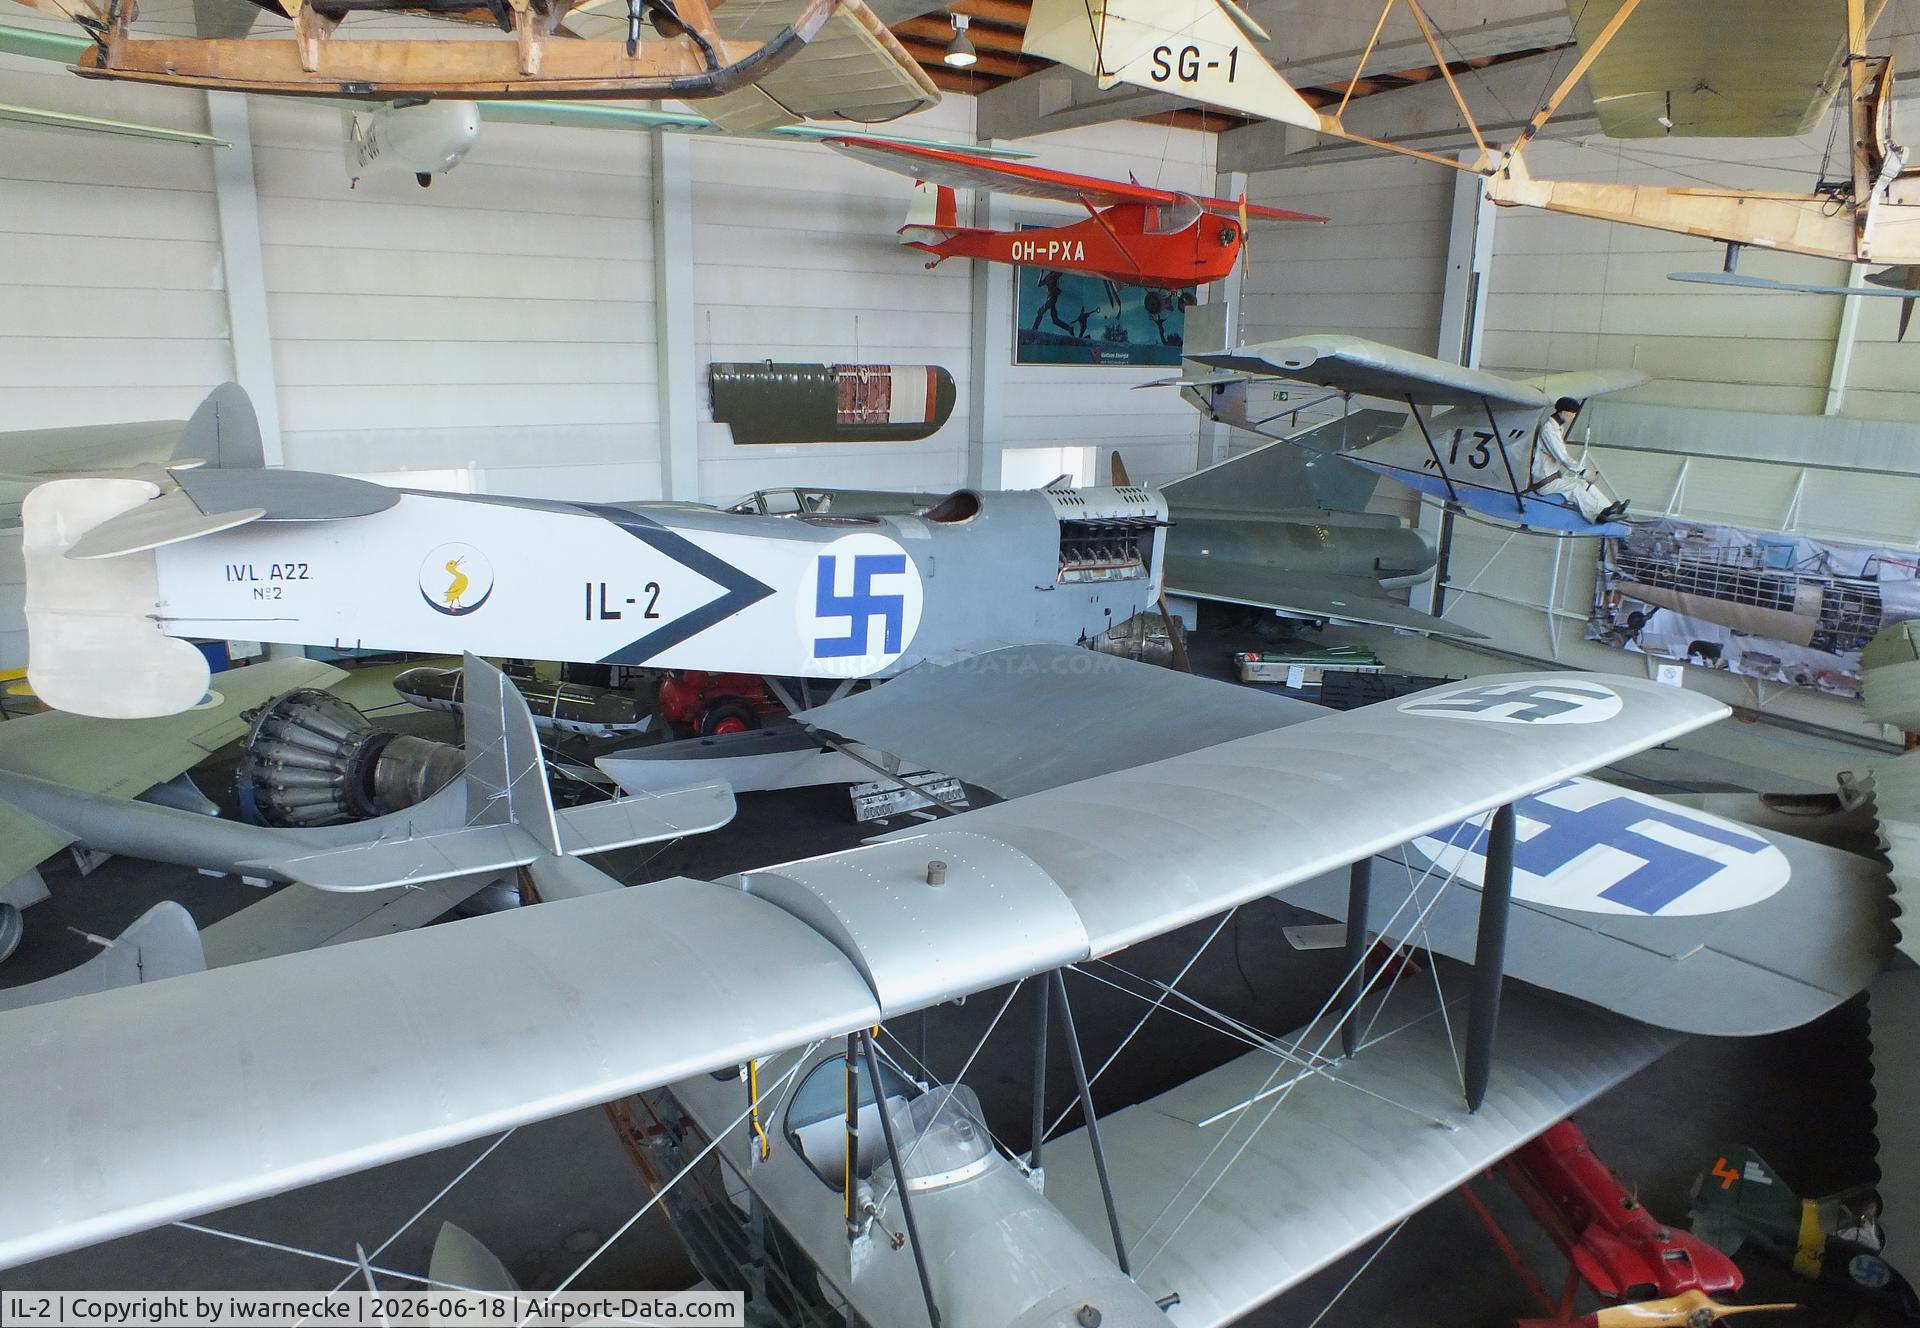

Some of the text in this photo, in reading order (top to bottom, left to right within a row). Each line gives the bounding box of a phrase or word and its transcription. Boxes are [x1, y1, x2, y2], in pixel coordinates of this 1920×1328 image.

[1151, 45, 1239, 83] SG-1
[1012, 240, 1085, 261] OH-PXA
[586, 581, 661, 621] IL-2
[1711, 1156, 1741, 1190] 4
